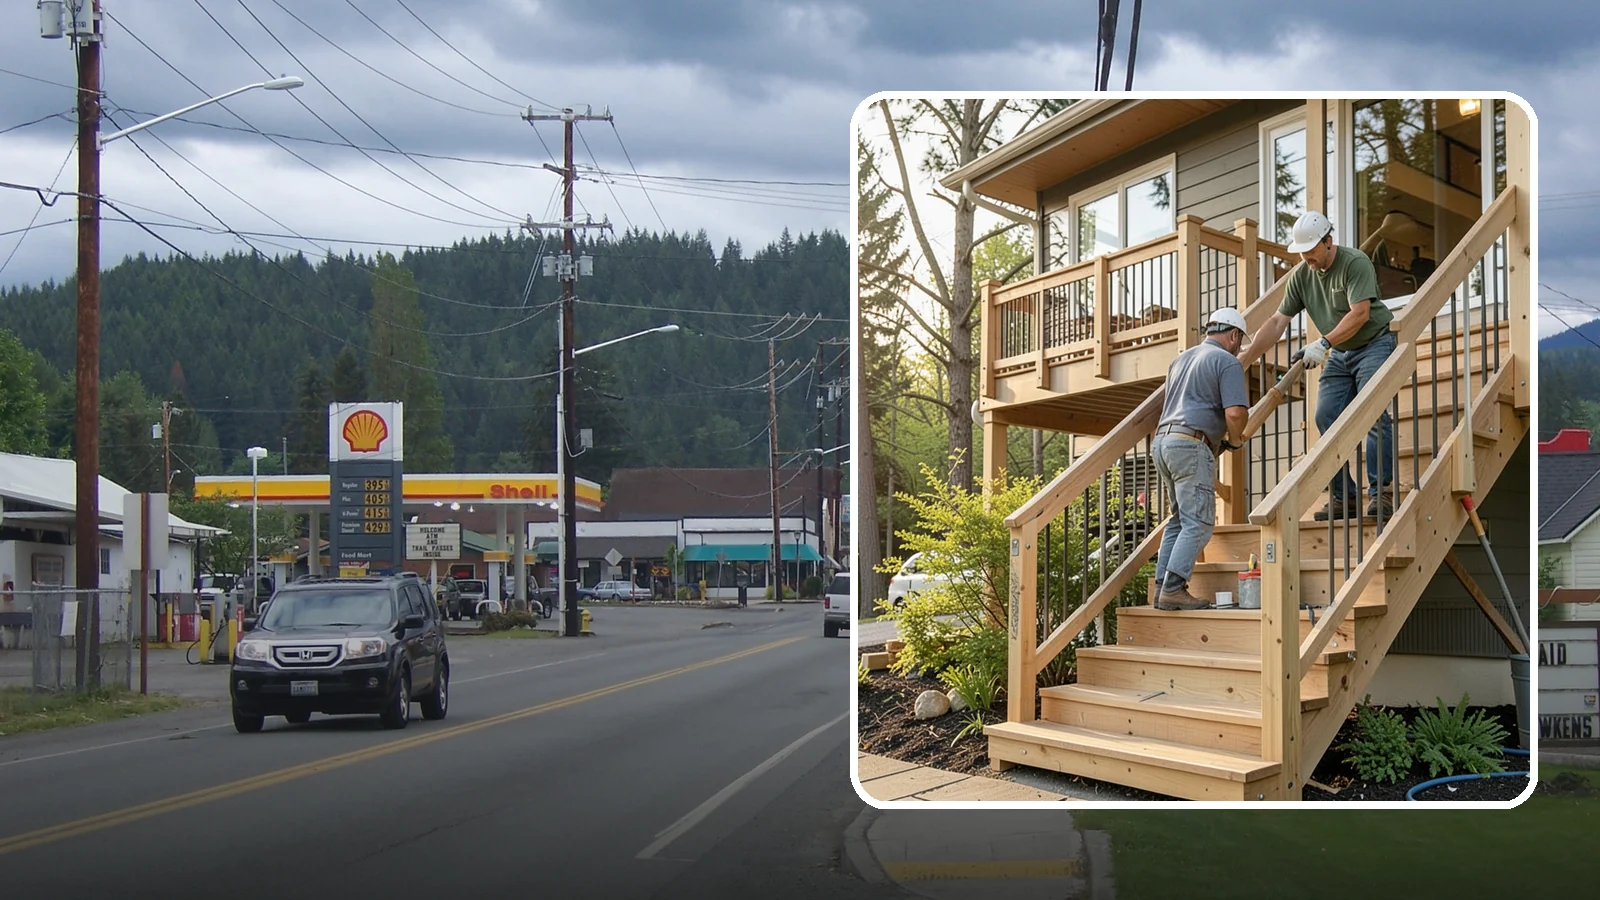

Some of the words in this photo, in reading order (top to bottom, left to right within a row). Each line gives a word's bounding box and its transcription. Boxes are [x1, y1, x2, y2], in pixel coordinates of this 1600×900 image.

[366, 480, 383, 490] 395
[490, 484, 547, 498] Shell
[366, 494, 383, 504] 405
[366, 508, 383, 518] 415
[366, 522, 383, 532] 429
